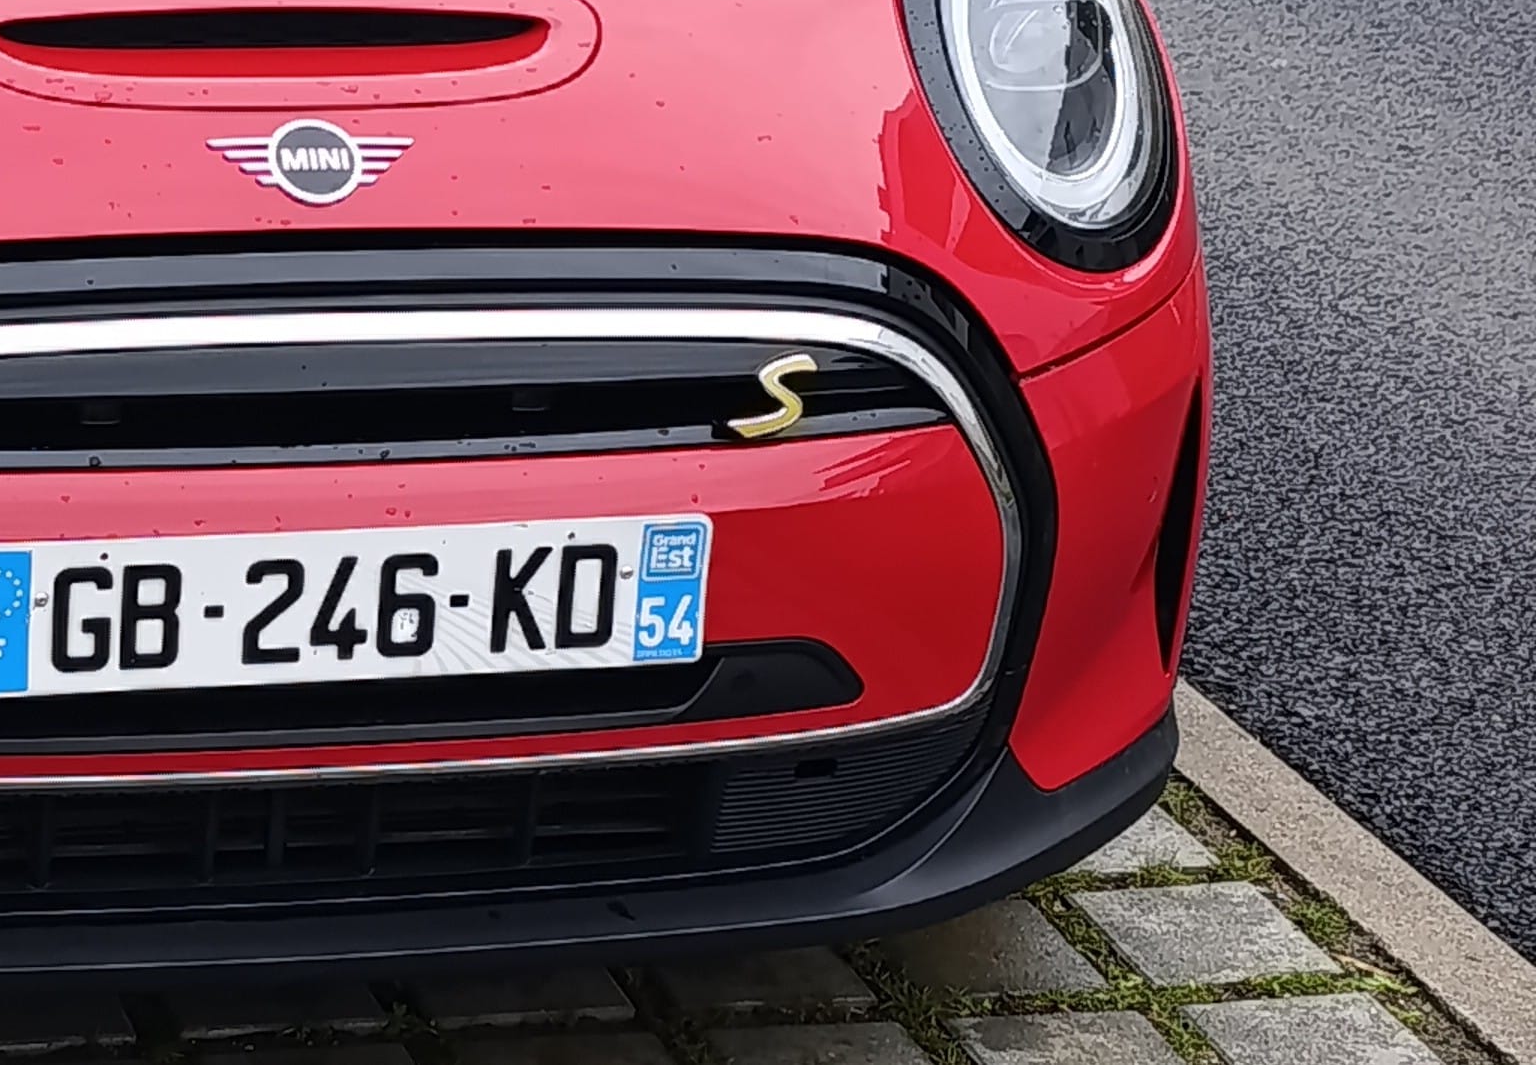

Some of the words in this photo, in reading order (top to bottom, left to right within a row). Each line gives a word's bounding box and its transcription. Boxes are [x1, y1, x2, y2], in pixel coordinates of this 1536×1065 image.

[279, 146, 352, 172] MINI
[726, 352, 819, 439] S
[652, 531, 697, 547] Grand
[649, 546, 695, 569] Est
[637, 593, 694, 648] 54
